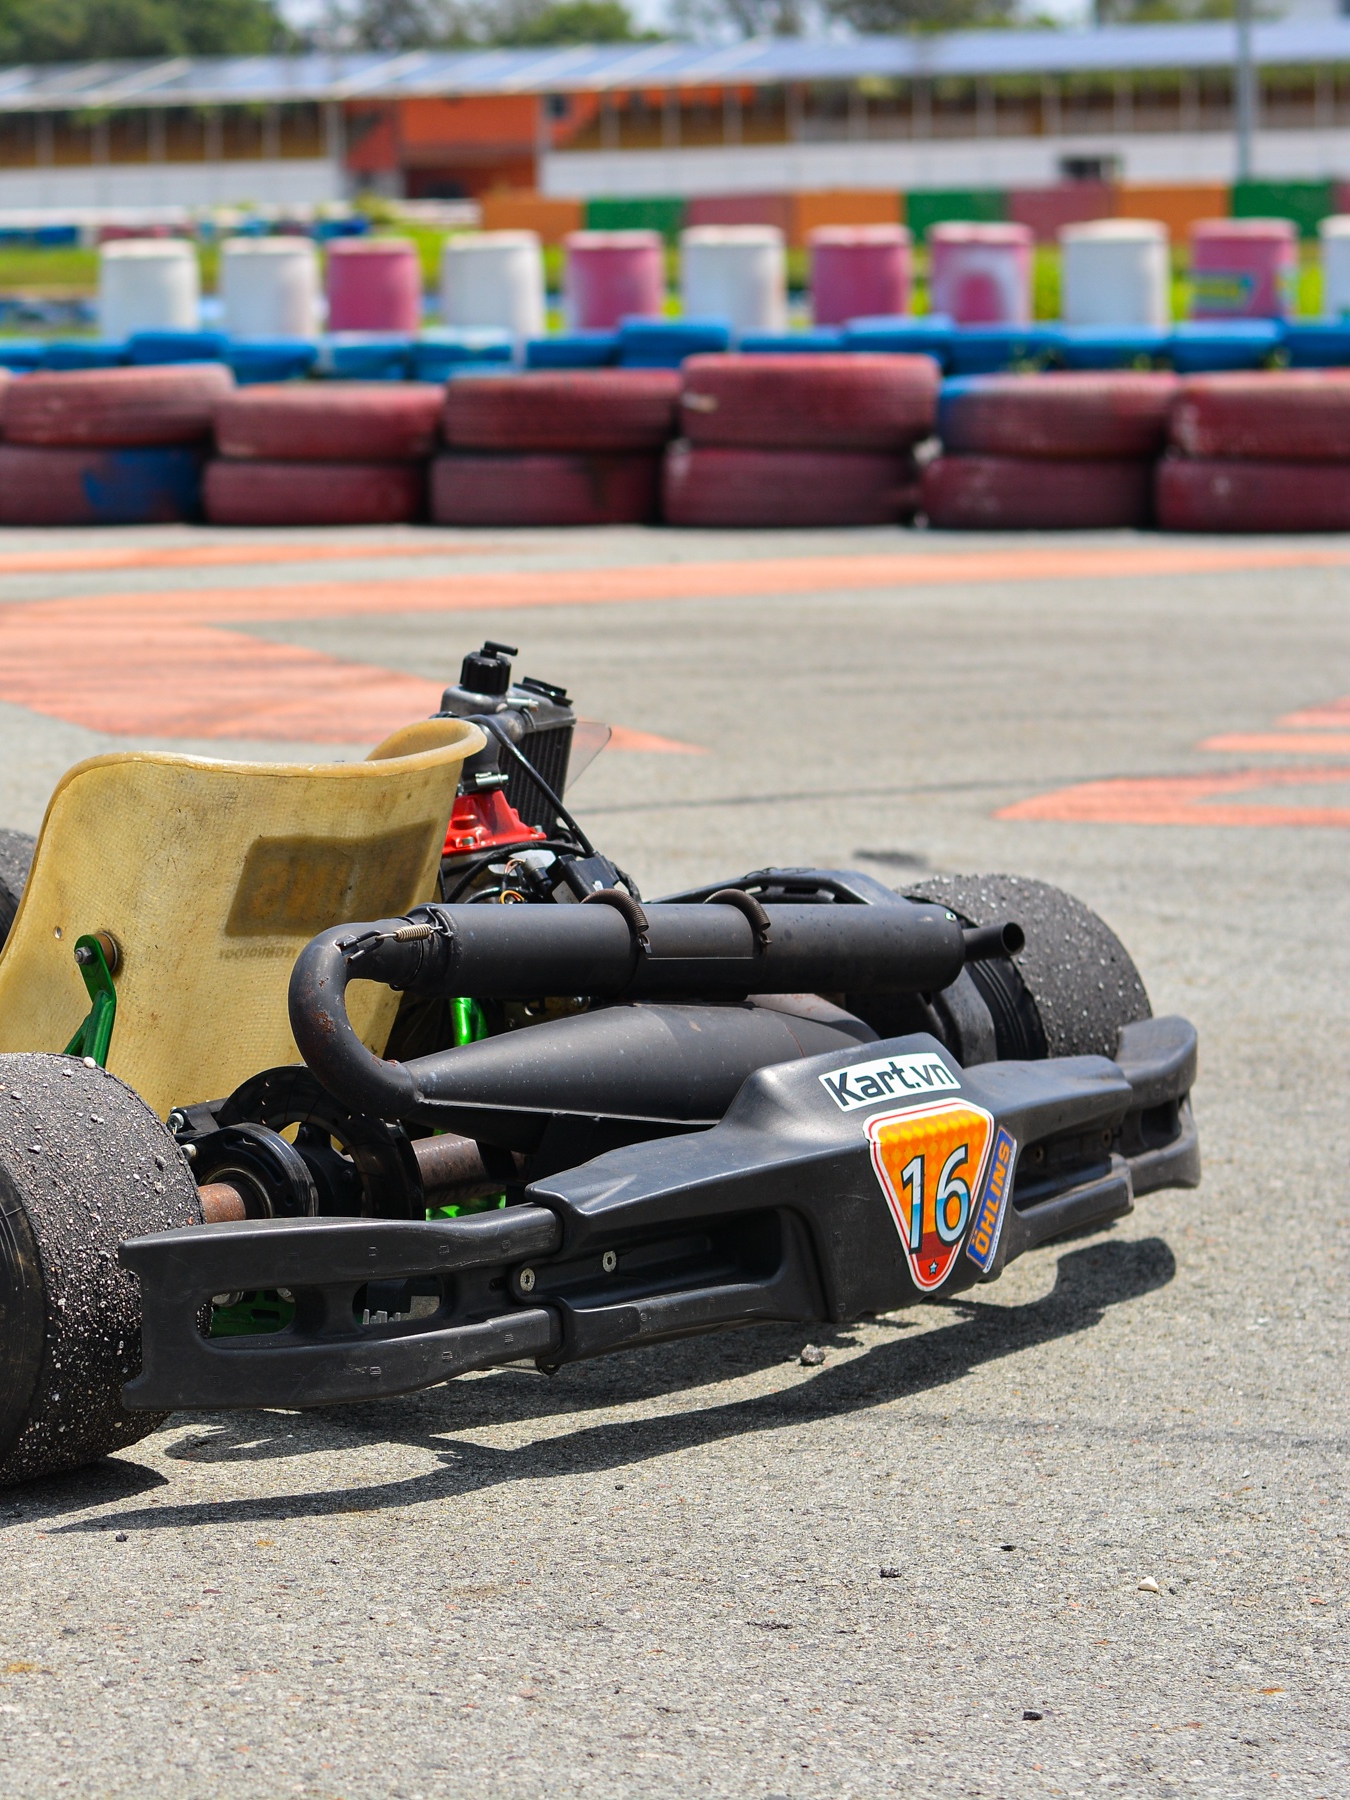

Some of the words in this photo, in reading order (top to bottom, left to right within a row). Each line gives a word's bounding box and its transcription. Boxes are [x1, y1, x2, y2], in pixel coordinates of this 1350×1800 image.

[823, 1060, 954, 1107] Kart.vn
[900, 1143, 971, 1255] 16
[971, 1142, 1012, 1256] ÖHLINS
